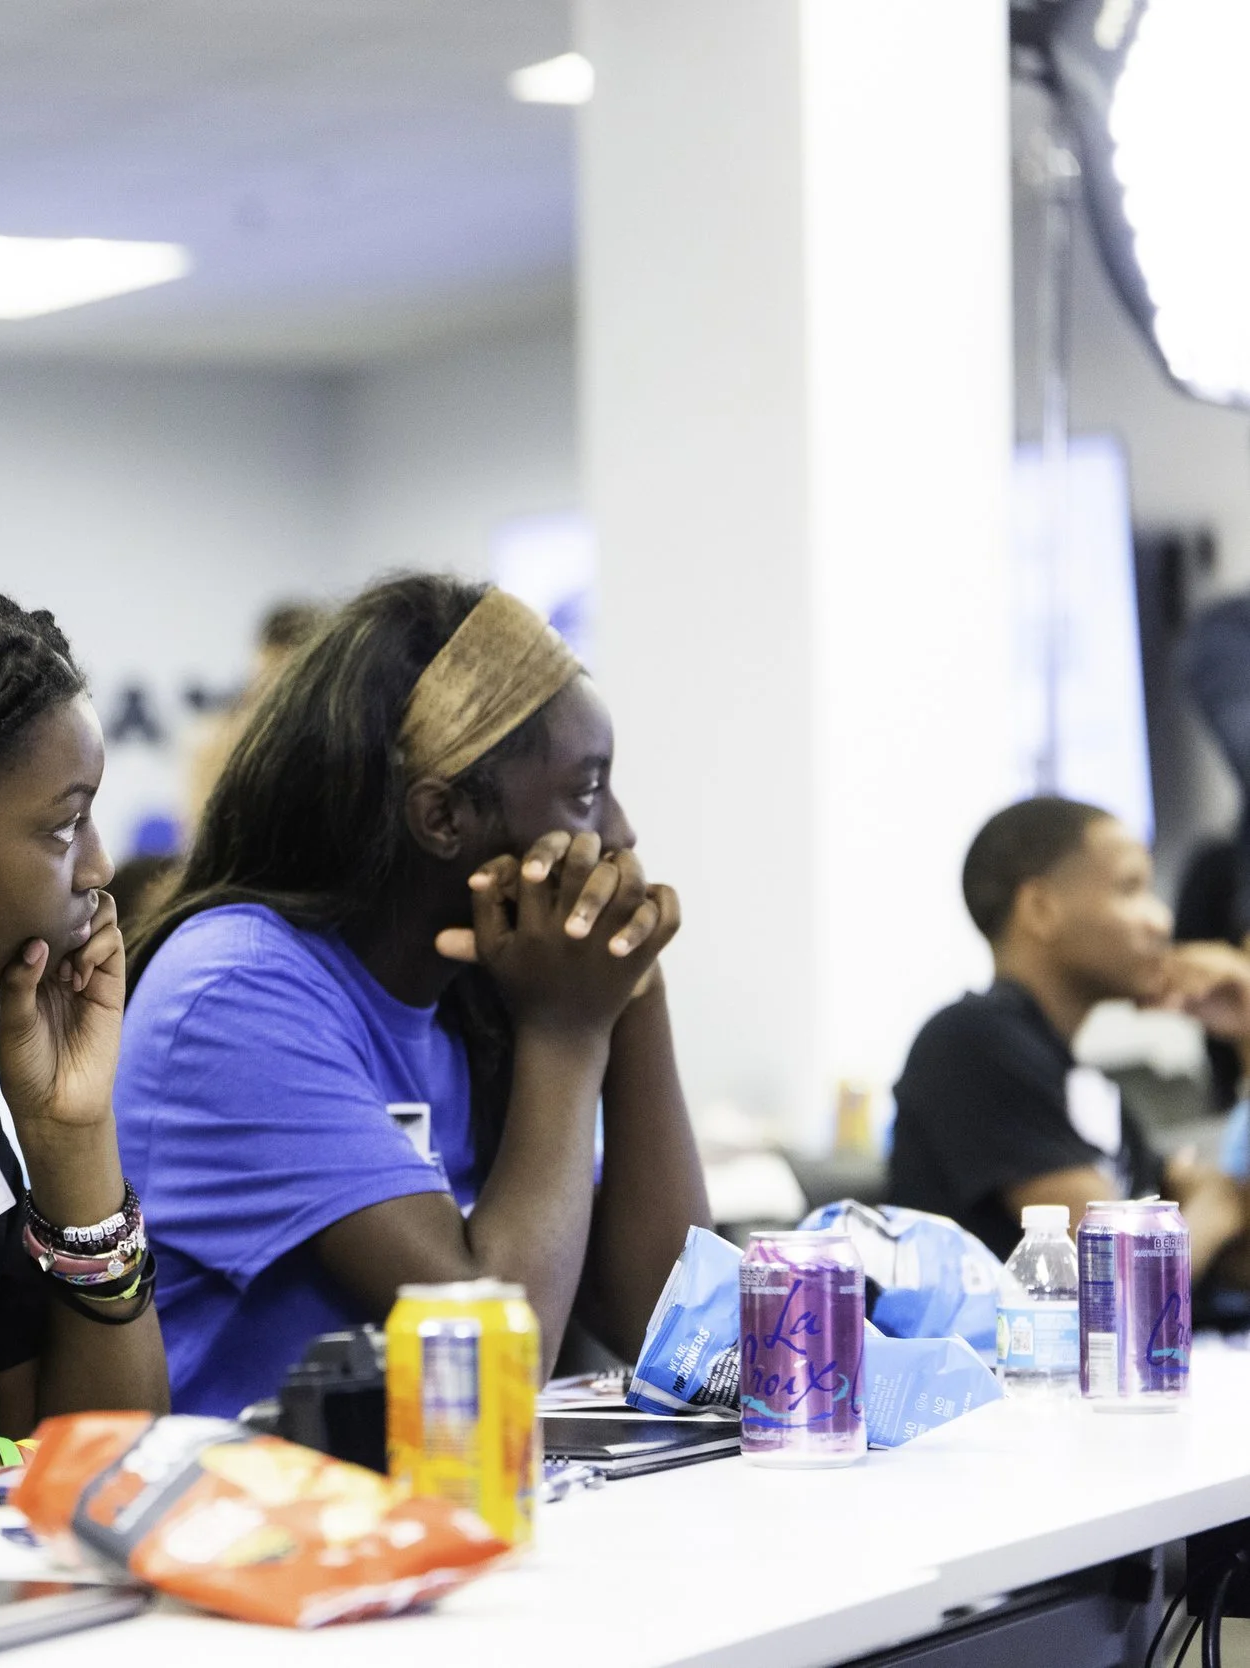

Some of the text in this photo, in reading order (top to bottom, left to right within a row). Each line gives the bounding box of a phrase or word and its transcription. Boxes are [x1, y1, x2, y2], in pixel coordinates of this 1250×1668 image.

[763, 1279, 822, 1354] La
[667, 1342, 689, 1373] WE ARE
[672, 1326, 711, 1394] POPCORNERS
